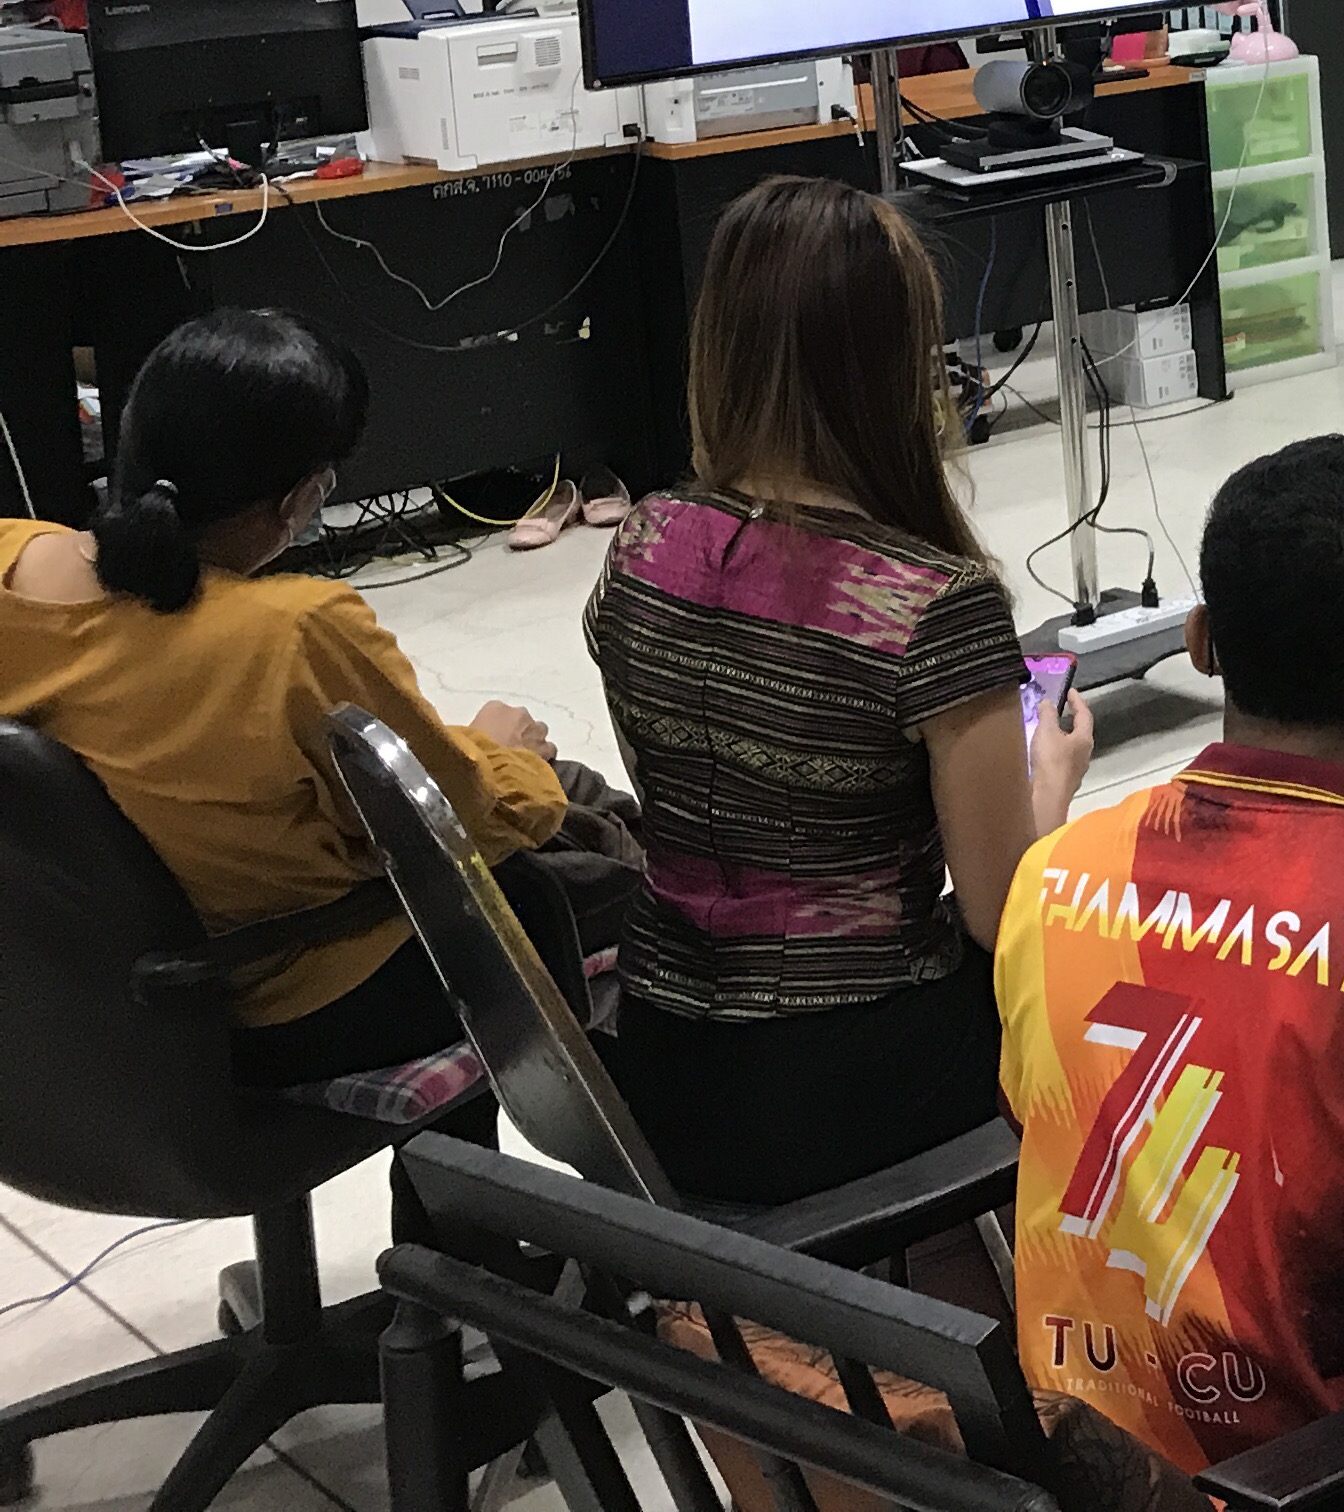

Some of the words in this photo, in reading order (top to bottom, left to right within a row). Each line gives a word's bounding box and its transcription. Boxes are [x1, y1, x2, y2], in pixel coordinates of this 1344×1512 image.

[1042, 1313, 1118, 1374] TU
[1177, 1351, 1266, 1404] CU
[1066, 1377, 1160, 1408] TRADITIONAL
[1168, 1401, 1241, 1424] FOOTBALL
